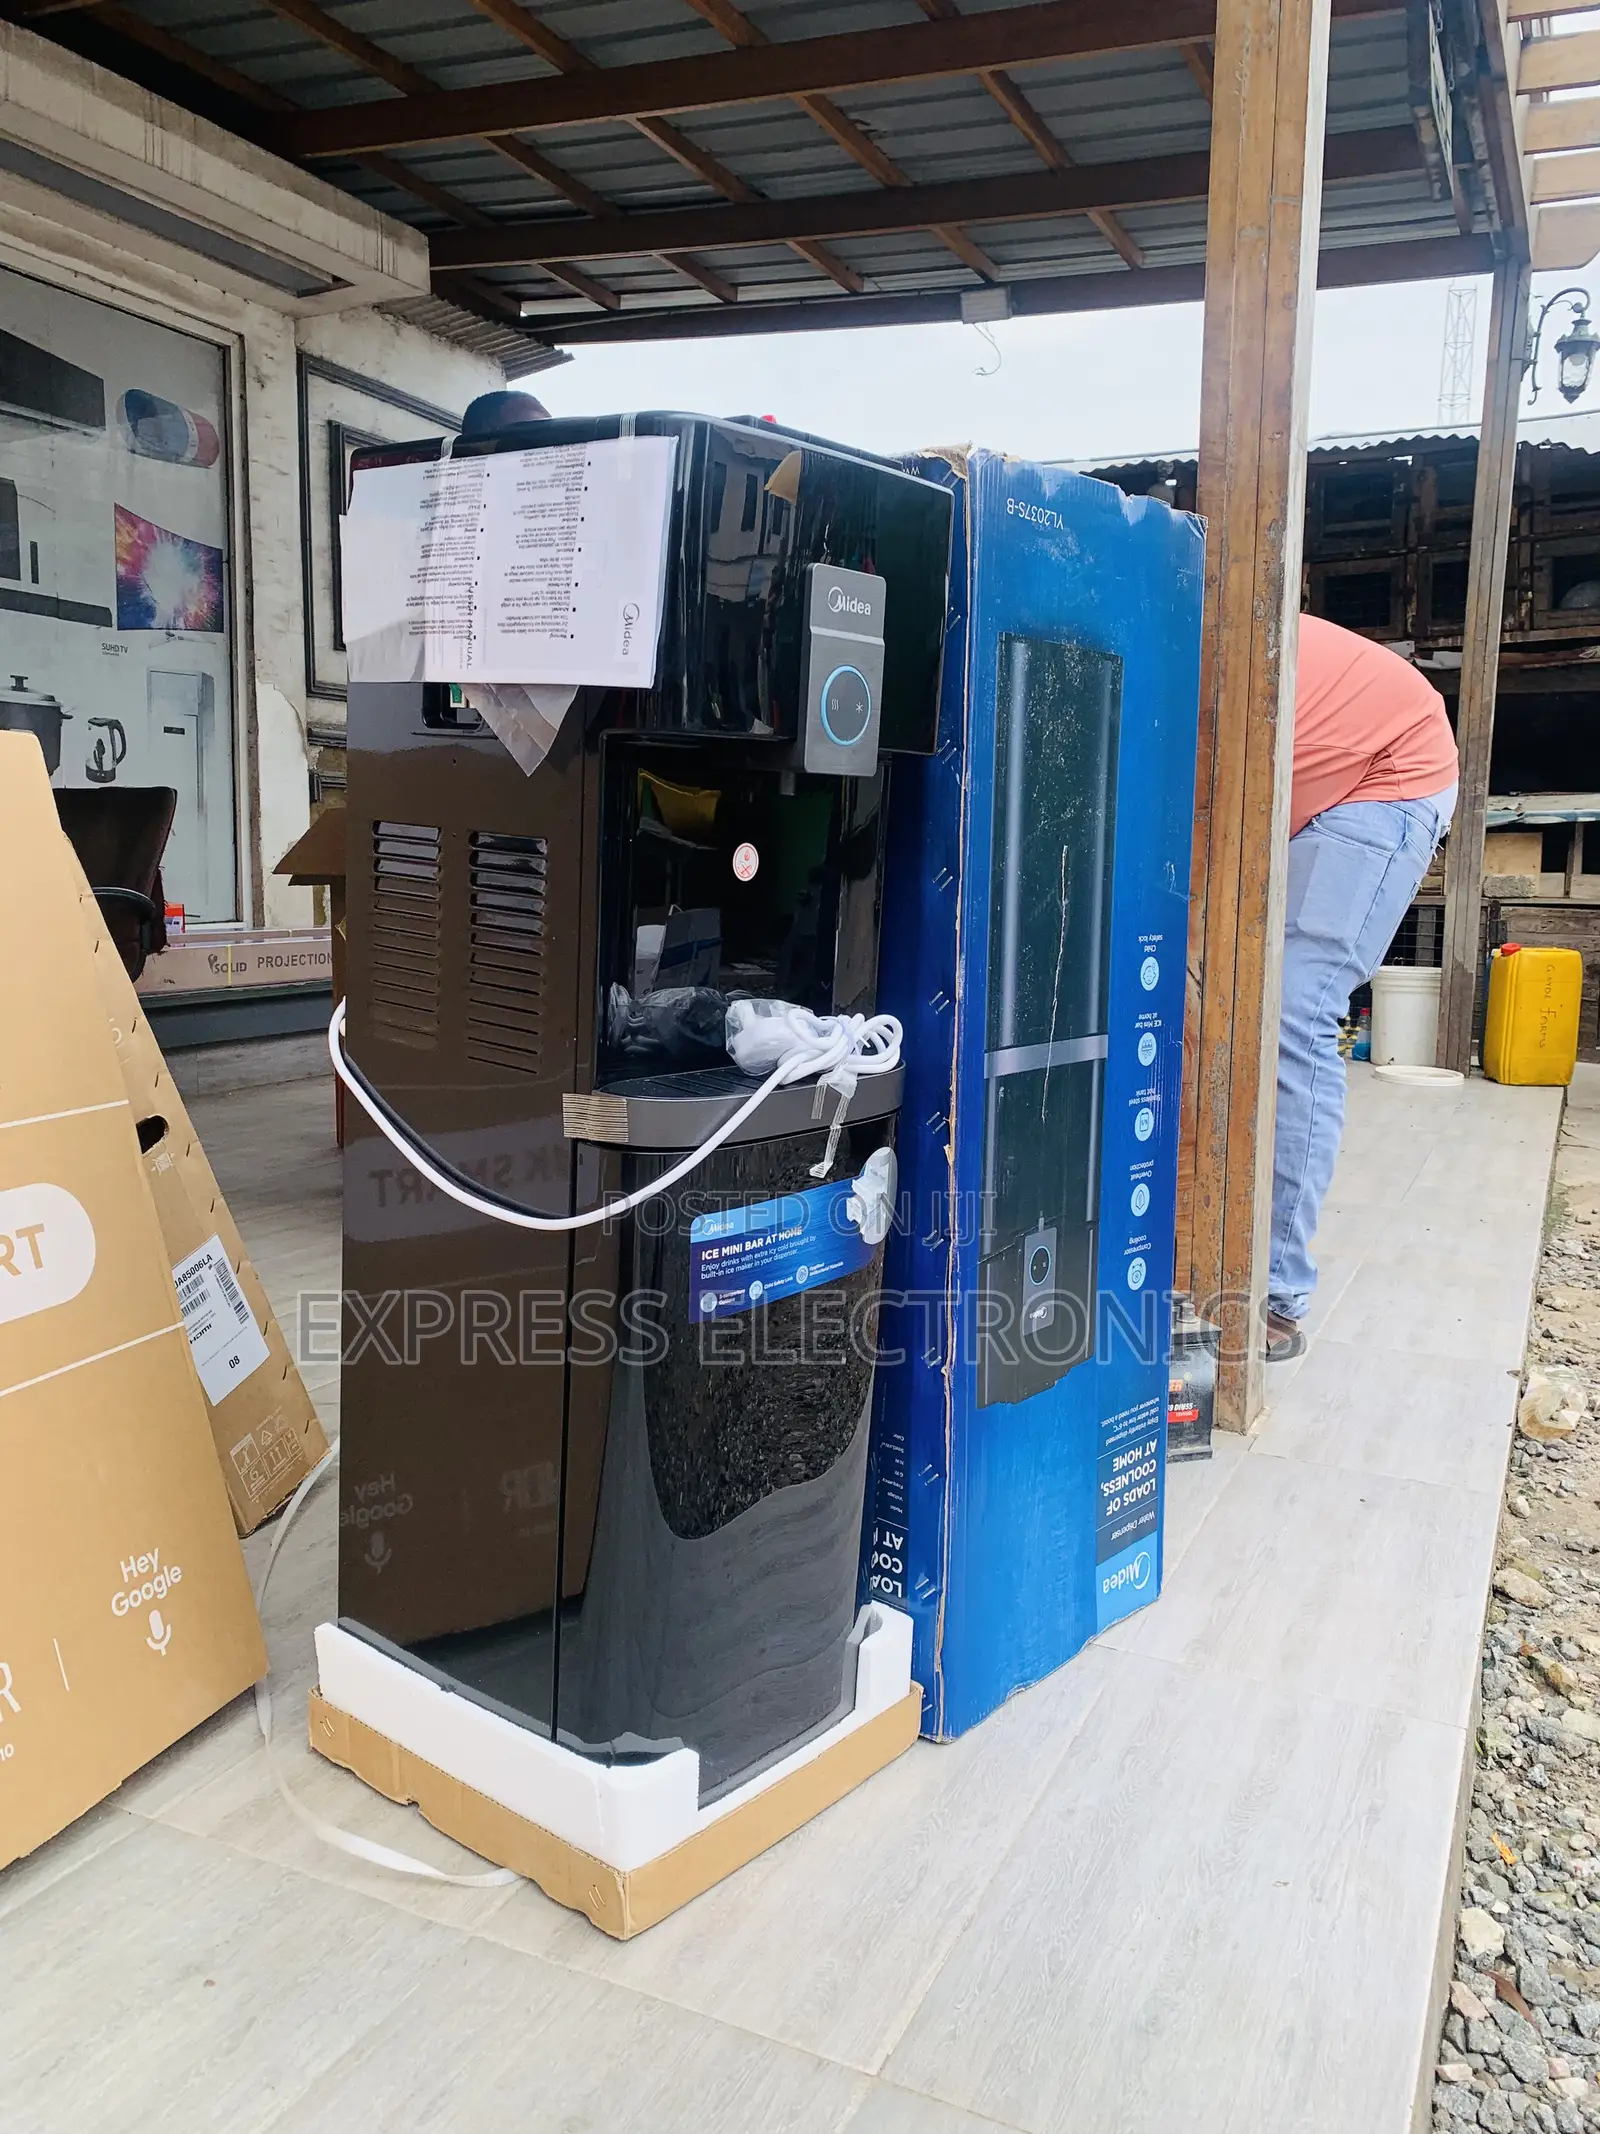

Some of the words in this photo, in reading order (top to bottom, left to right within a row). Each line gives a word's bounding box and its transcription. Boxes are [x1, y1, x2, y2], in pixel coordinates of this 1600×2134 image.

[1006, 497, 1064, 530] YL2037S-B
[828, 586, 871, 616] Midea
[621, 602, 640, 656] Midea
[120, 645, 128, 654] TV
[1138, 935, 1148, 944] lock
[1148, 934, 1163, 942] safety
[1144, 944, 1156, 953] Child
[214, 962, 248, 974] SOLID
[1138, 1013, 1152, 1022] home
[1152, 1012, 1158, 1020] at
[1134, 1022, 1144, 1030] bar
[1154, 1020, 1162, 1028] ICE
[1135, 1089, 1146, 1098] tank
[1128, 1097, 1140, 1107] steel
[1129, 1160, 1154, 1172] protection
[1130, 1169, 1152, 1182] Overheat
[702, 1248, 720, 1260] ICE
[722, 1244, 742, 1257] MINI
[744, 1239, 764, 1251] BAR
[766, 1234, 778, 1245] AT
[778, 1226, 803, 1241] HOME
[1128, 1234, 1147, 1246] cooling
[701, 1262, 720, 1273] Enjoy
[721, 1258, 740, 1267] drinks
[740, 1254, 754, 1262] with
[754, 1251, 768, 1259] extra
[768, 1248, 777, 1256] icy
[778, 1242, 788, 1252] cold
[790, 1237, 810, 1250] brought
[810, 1235, 816, 1243] by
[1124, 1241, 1152, 1256] Compressor
[700, 1268, 724, 1280] built-in
[726, 1266, 735, 1274] ice
[736, 1262, 754, 1272] maker
[760, 1257, 772, 1267] your
[228, 1355, 240, 1369] 08
[1130, 1404, 1139, 1413] you
[1138, 1396, 1160, 1409] whenever
[1118, 1410, 1130, 1420] need
[1136, 1410, 1150, 1422] water
[1149, 1406, 1160, 1416] cold
[1123, 1420, 1128, 1428] to
[1128, 1416, 1137, 1424] low
[1146, 1416, 1159, 1426] Enjoy
[1128, 1422, 1146, 1435] instantly
[1105, 1430, 1128, 1447] dispensed
[1144, 1438, 1158, 1457] AT
[1112, 1445, 1142, 1473] HOME
[1100, 1458, 1156, 1497] COOLNESS,
[1124, 1478, 1156, 1507] LOADS
[1106, 1496, 1121, 1516] OF
[1138, 1510, 1156, 1528] Water
[1110, 1518, 1138, 1541] Dispenser
[882, 1530, 904, 1550] AT
[120, 1547, 159, 1584] Hey
[1102, 1551, 1151, 1594] Midea
[111, 1565, 182, 1617] Google
